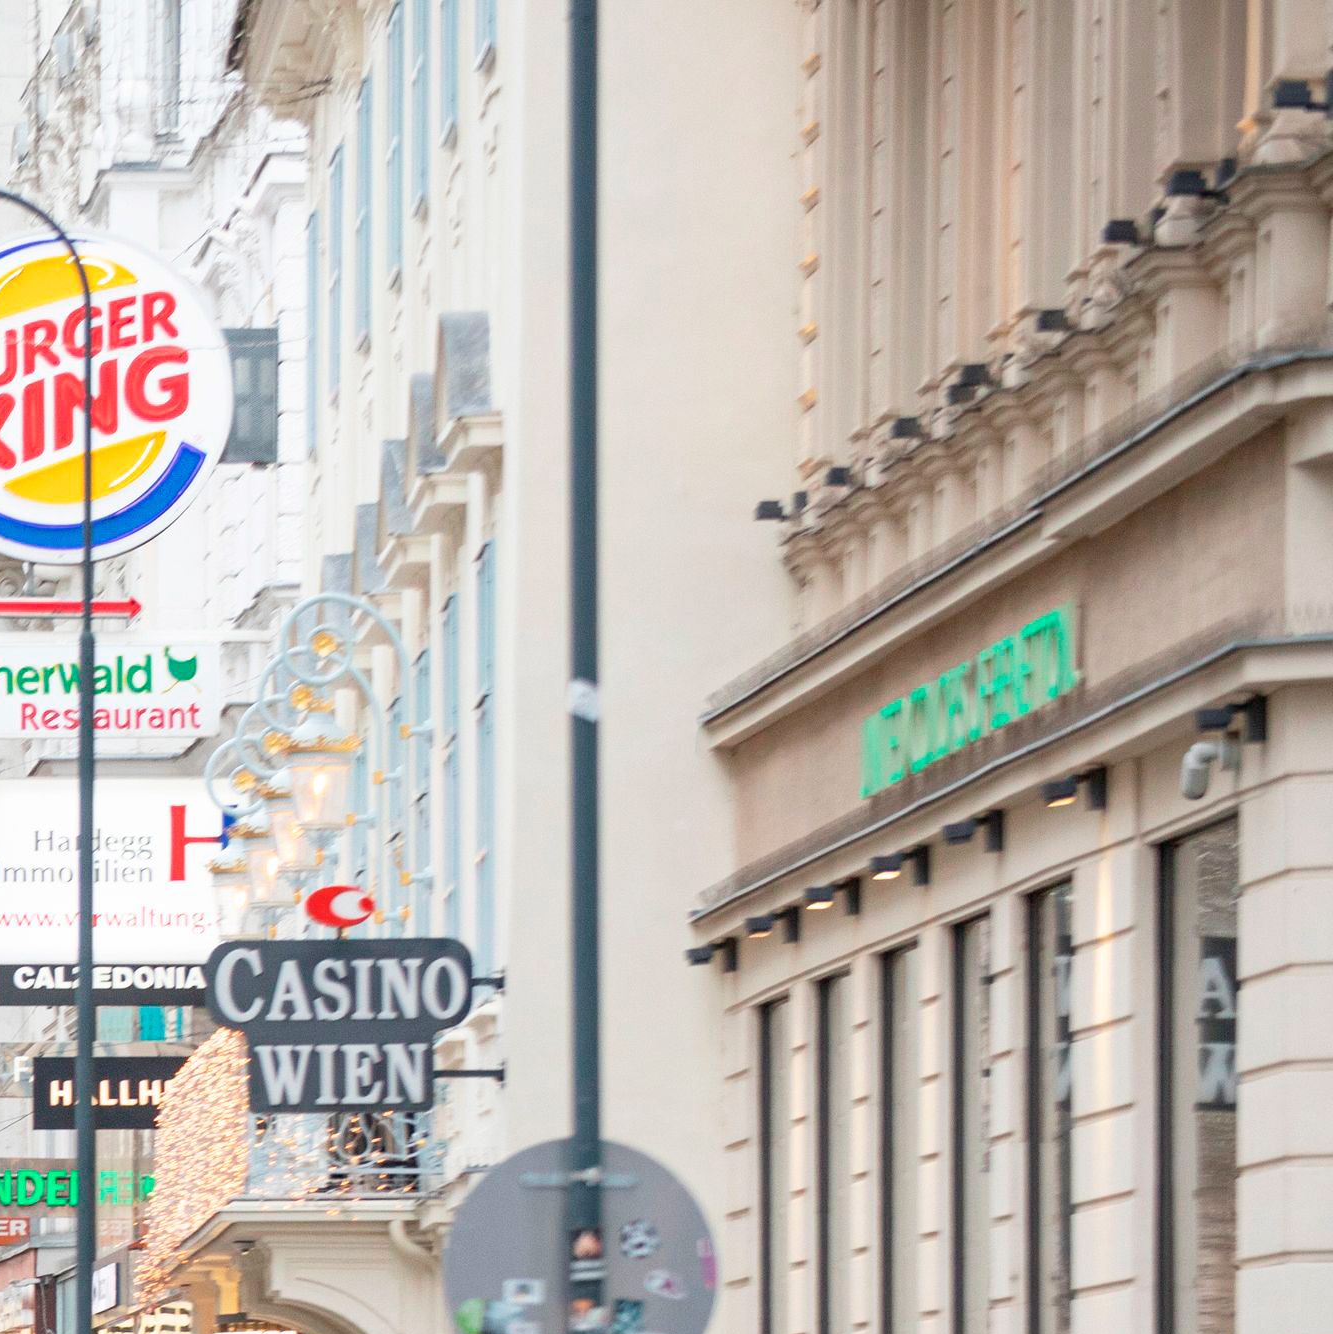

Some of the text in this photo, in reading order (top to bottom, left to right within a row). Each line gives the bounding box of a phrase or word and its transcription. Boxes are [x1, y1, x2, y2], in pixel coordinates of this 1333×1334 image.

[20, 702, 200, 731] Resaurant
[215, 948, 468, 1023] CASINO
[49, 1079, 165, 1107] HLLH
[255, 1043, 430, 1106] WIEN
